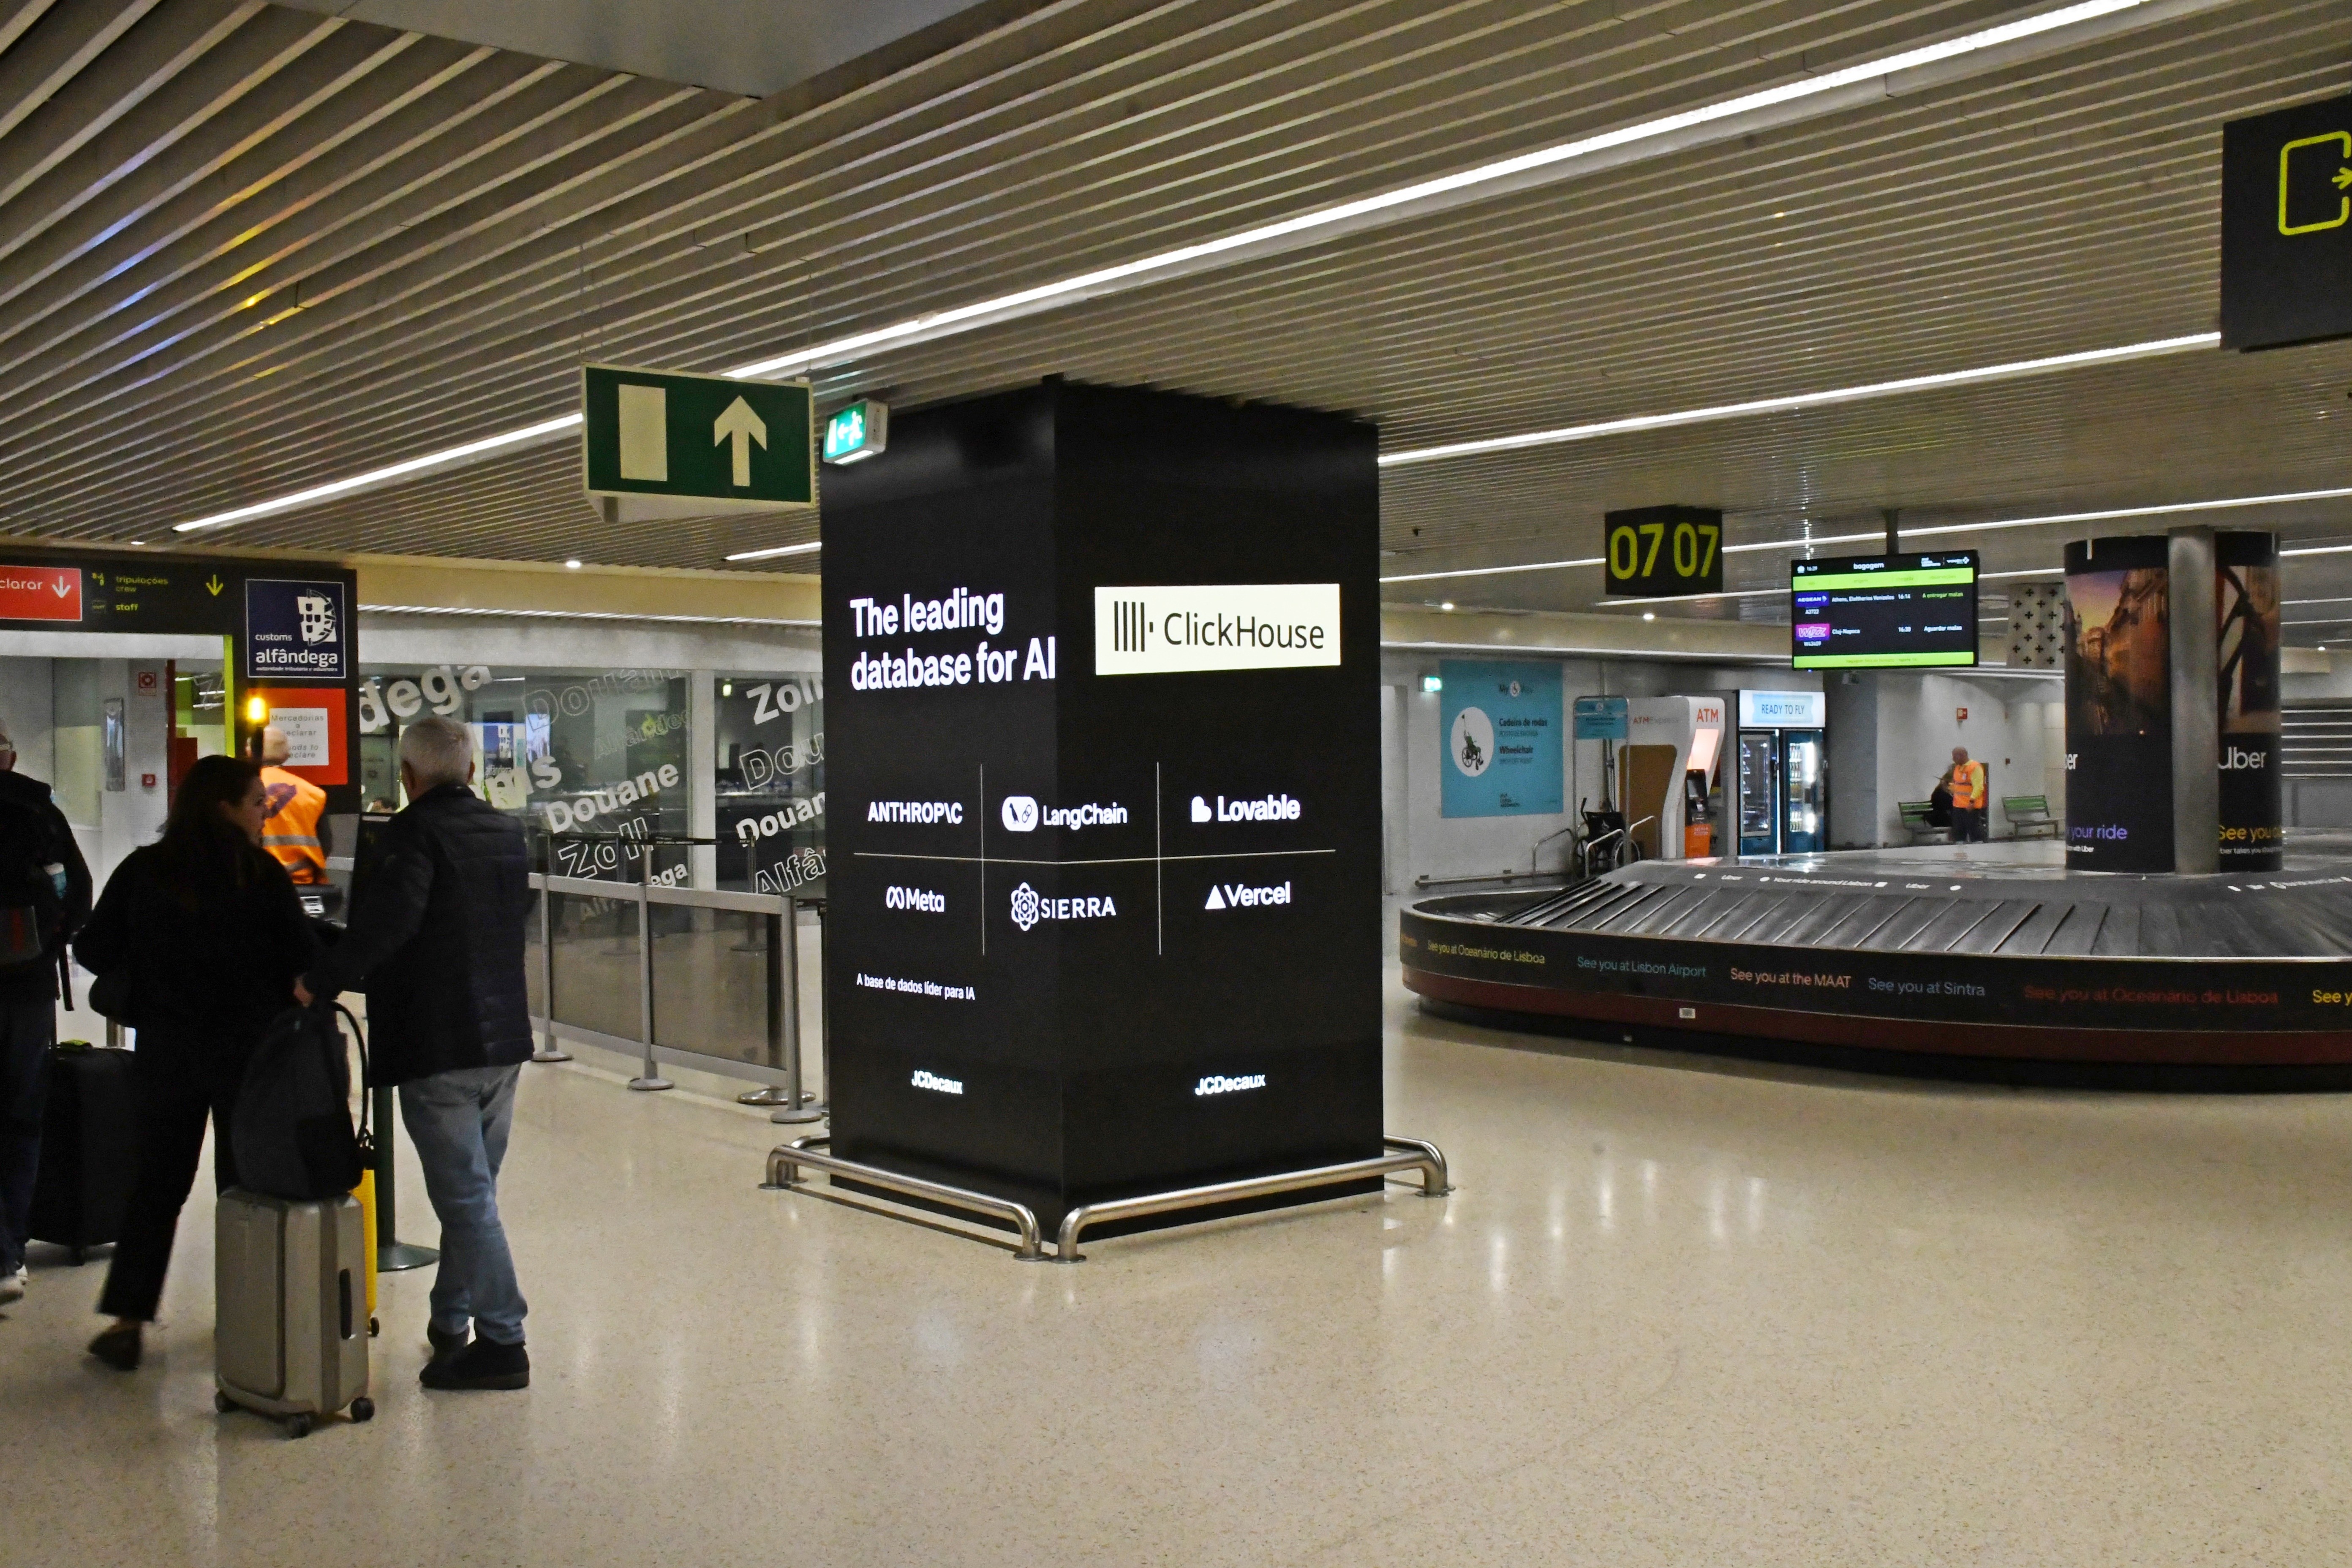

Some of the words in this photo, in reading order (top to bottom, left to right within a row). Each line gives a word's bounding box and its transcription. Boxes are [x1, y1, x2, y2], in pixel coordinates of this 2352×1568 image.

[1610, 523, 1664, 580] 07
[1673, 522, 1718, 577] 07
[116, 603, 139, 611] staff
[850, 597, 898, 637] The
[904, 587, 1004, 635] leading
[255, 633, 292, 641] customs
[1164, 612, 1324, 649] ClickHouse
[256, 648, 338, 667] alfândega
[851, 648, 971, 690] database
[977, 642, 1017, 683] for
[1024, 637, 1056, 681] AI
[1696, 708, 1718, 722] ATM
[1761, 704, 1782, 715] READY
[1785, 704, 1793, 714] TO
[1794, 704, 1805, 715] FLY
[1499, 745, 1533, 754] Wheelchair
[545, 764, 679, 834] Douane
[1217, 794, 1300, 822] Lovable
[1043, 802, 1127, 830] LangChain
[2096, 824, 2128, 840] ride
[2219, 825, 2247, 840] See
[906, 887, 945, 912] Meta
[1224, 881, 1291, 906] Vercel
[1041, 896, 1116, 919] SIERRA
[1458, 944, 1498, 960] Oceanário
[1500, 950, 1512, 961] de
[1514, 951, 1545, 964] Lisboa
[1578, 956, 1597, 969] See
[1599, 960, 1617, 972] you
[1619, 961, 1629, 972] at
[1631, 960, 1666, 974] Lisbon
[1668, 963, 1706, 977] Airport
[856, 973, 863, 985] A
[864, 974, 884, 989] base
[885, 977, 896, 990] de
[897, 978, 923, 994] dados
[924, 980, 943, 996] líder
[944, 985, 964, 1000] para
[966, 986, 975, 1000] IA
[1731, 967, 1753, 981] See
[1755, 972, 1776, 985] you
[1778, 973, 1790, 984] at
[1792, 972, 1812, 985] the
[1814, 974, 1851, 988] MAAT
[1868, 977, 1895, 991] See
[1897, 981, 1922, 995] you
[1926, 981, 1940, 994] at
[1944, 981, 1985, 996] Sintra
[2023, 984, 2055, 1000] See
[2059, 989, 2089, 1003] you
[2092, 988, 2108, 1001] at
[2201, 989, 2221, 1003] de
[2226, 990, 2278, 1004] Lisboa
[2313, 989, 2341, 1004] See
[912, 1070, 963, 1095] JCDecaux
[1195, 1074, 1266, 1096] JCDecaux
